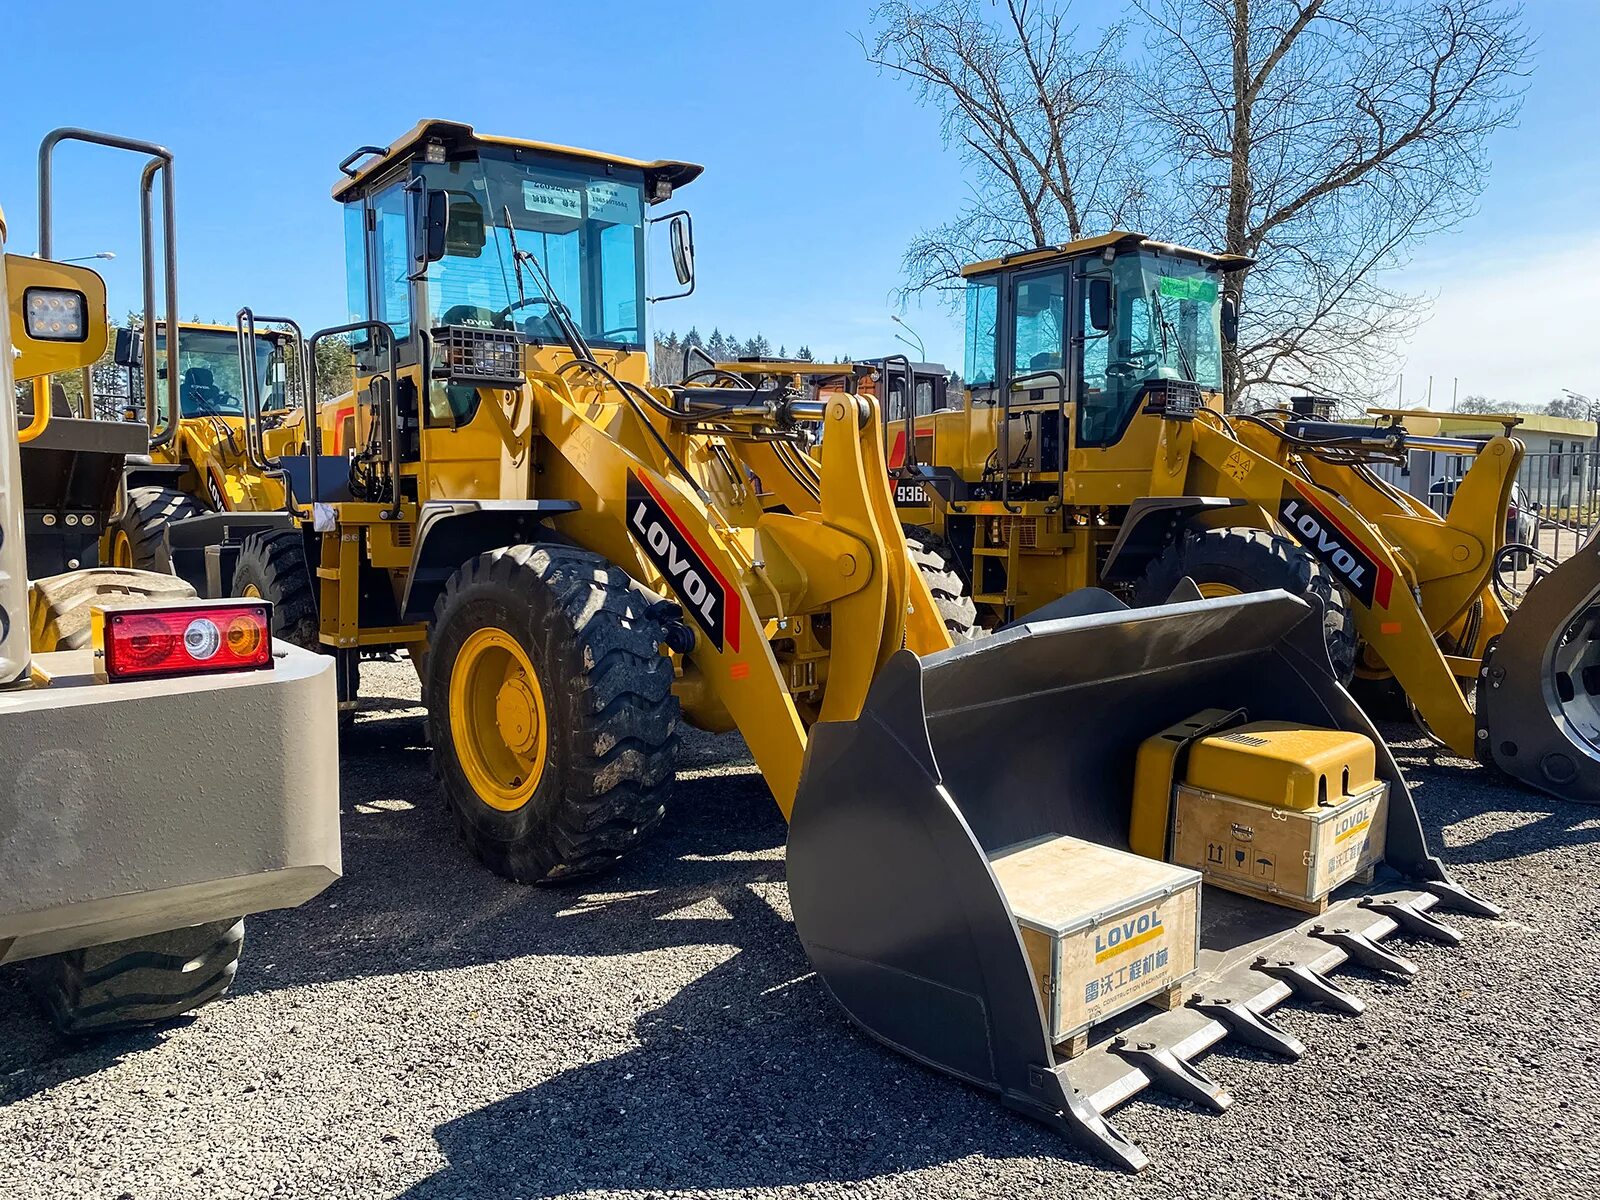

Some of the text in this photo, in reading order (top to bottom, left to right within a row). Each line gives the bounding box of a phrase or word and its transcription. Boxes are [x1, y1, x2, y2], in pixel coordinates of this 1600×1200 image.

[461, 318, 495, 327] LOVOL
[632, 502, 717, 627] LOVOL
[1283, 500, 1366, 588] LOVOL
[1335, 808, 1369, 836] LOVOL
[1095, 910, 1162, 954] LOVOL
[1085, 946, 1169, 1004] 雷沃工程机械
[1103, 983, 1141, 1006] CONSTRUCTION
[1140, 970, 1168, 987] MACHINERY
